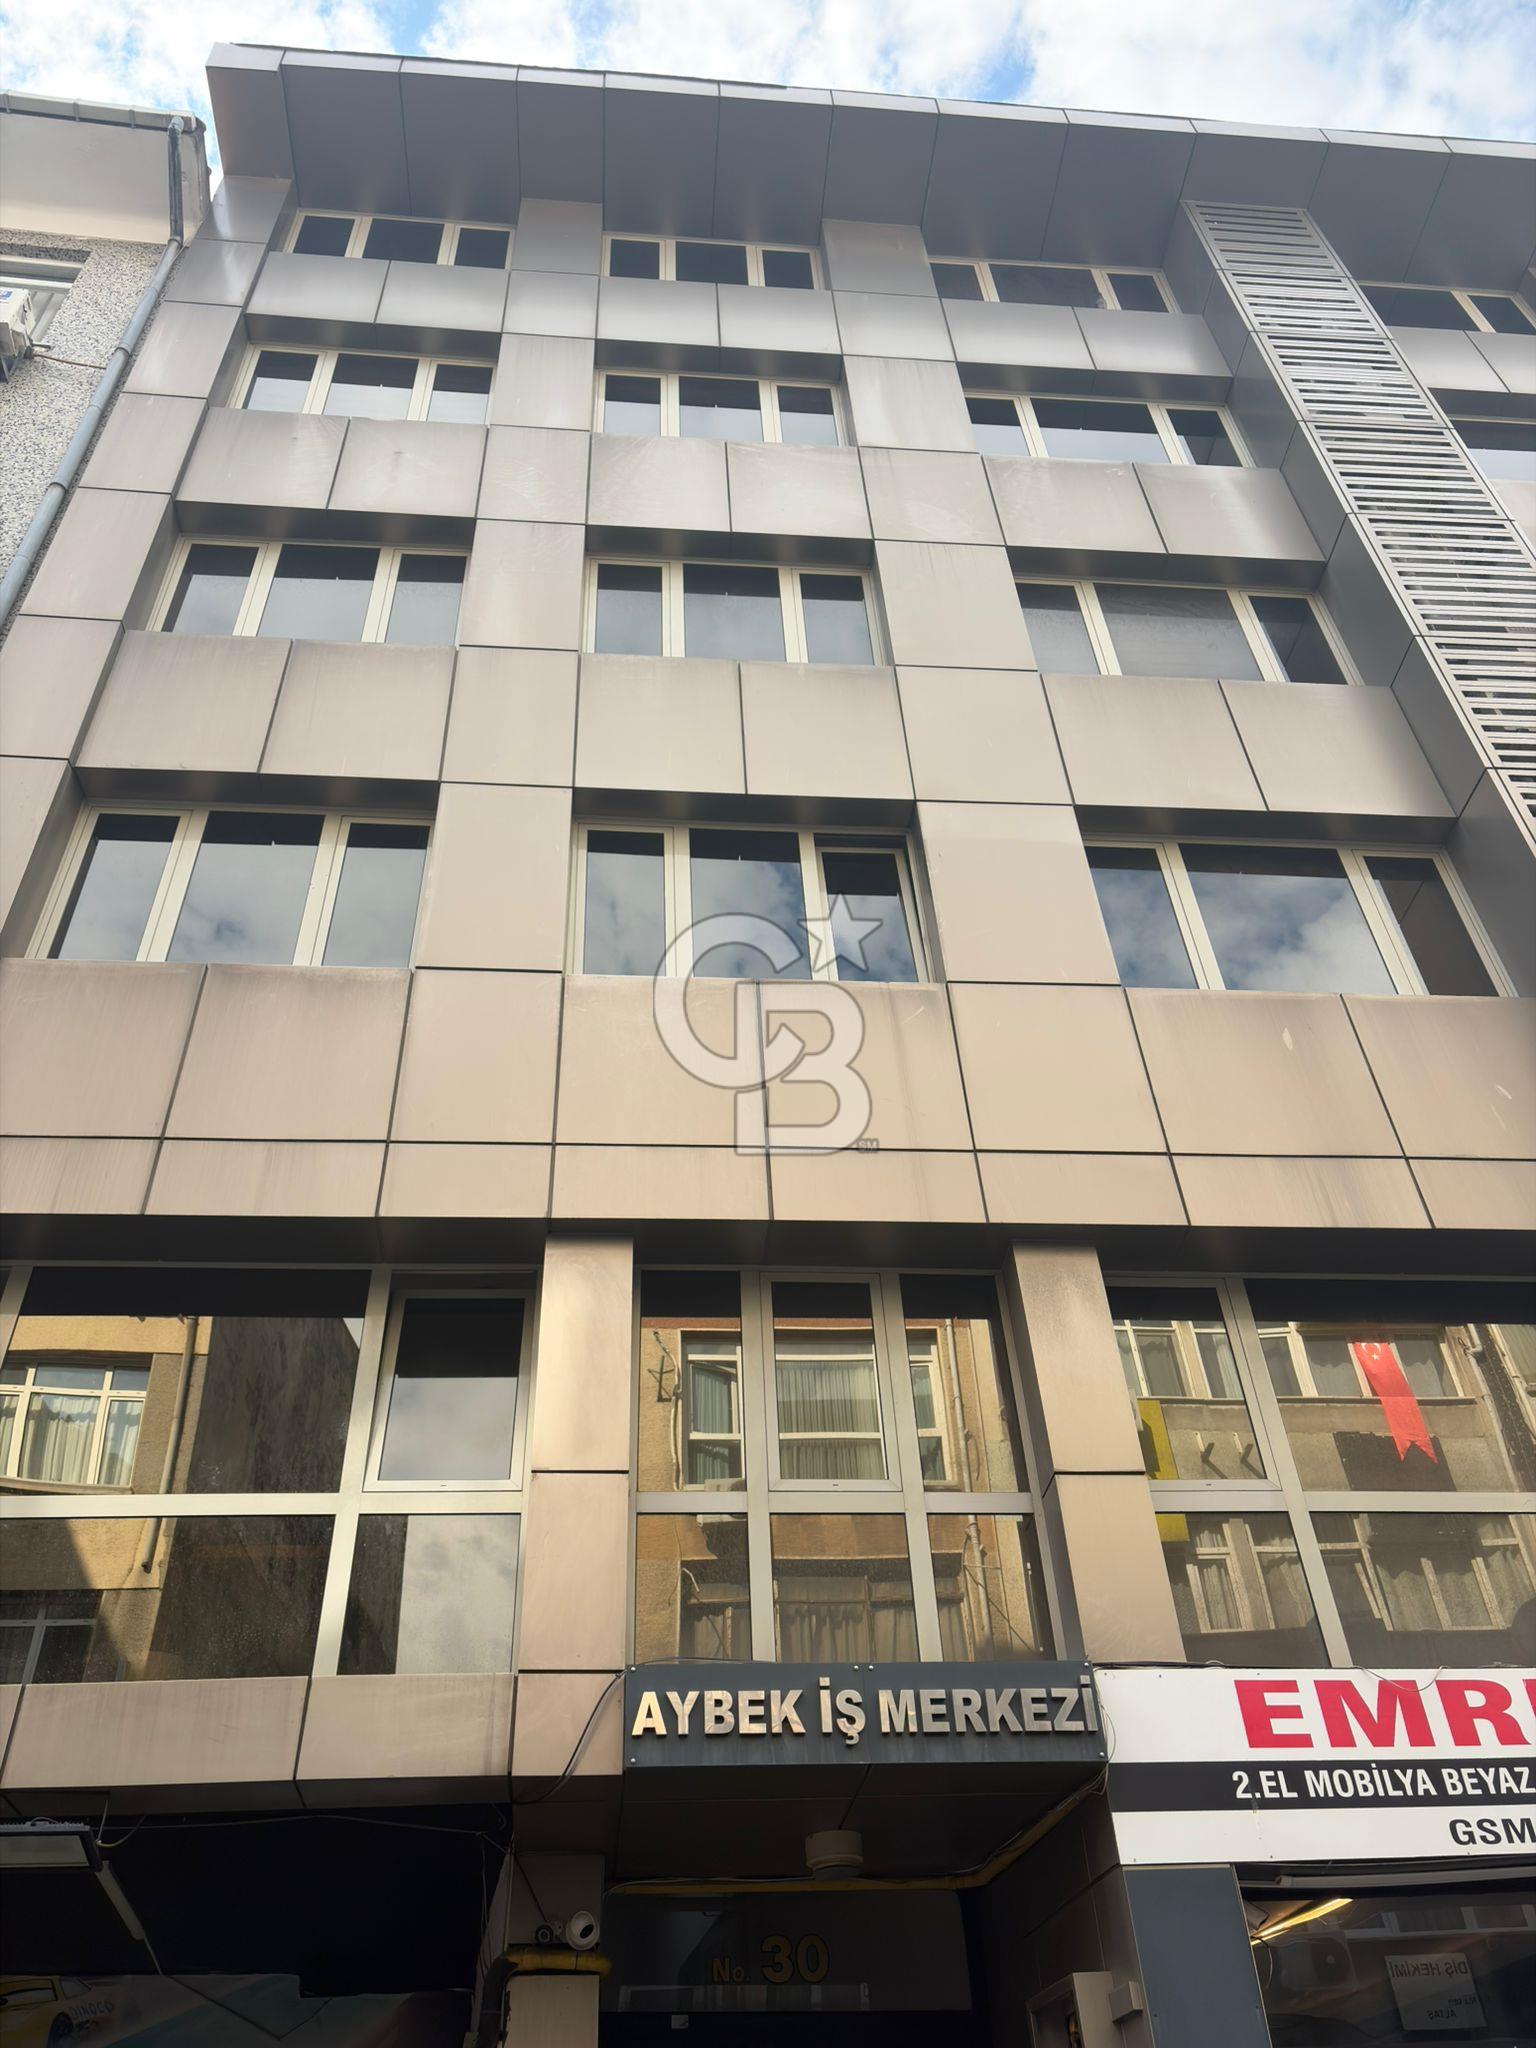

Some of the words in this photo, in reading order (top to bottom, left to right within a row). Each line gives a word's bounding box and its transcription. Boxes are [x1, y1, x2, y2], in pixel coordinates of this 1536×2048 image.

[631, 1689, 807, 1737] AYBEK
[818, 1676, 867, 1746] İŞ
[878, 1674, 1099, 1734] MERKEZİ
[1231, 1769, 1299, 1800] 2.EL
[1303, 1762, 1438, 1799] MOBİLYA
[1441, 1766, 1536, 1796] BEYAZ
[1449, 1817, 1536, 1846] GSM
[711, 1956, 751, 1985] No.
[759, 1932, 831, 1986] 30
